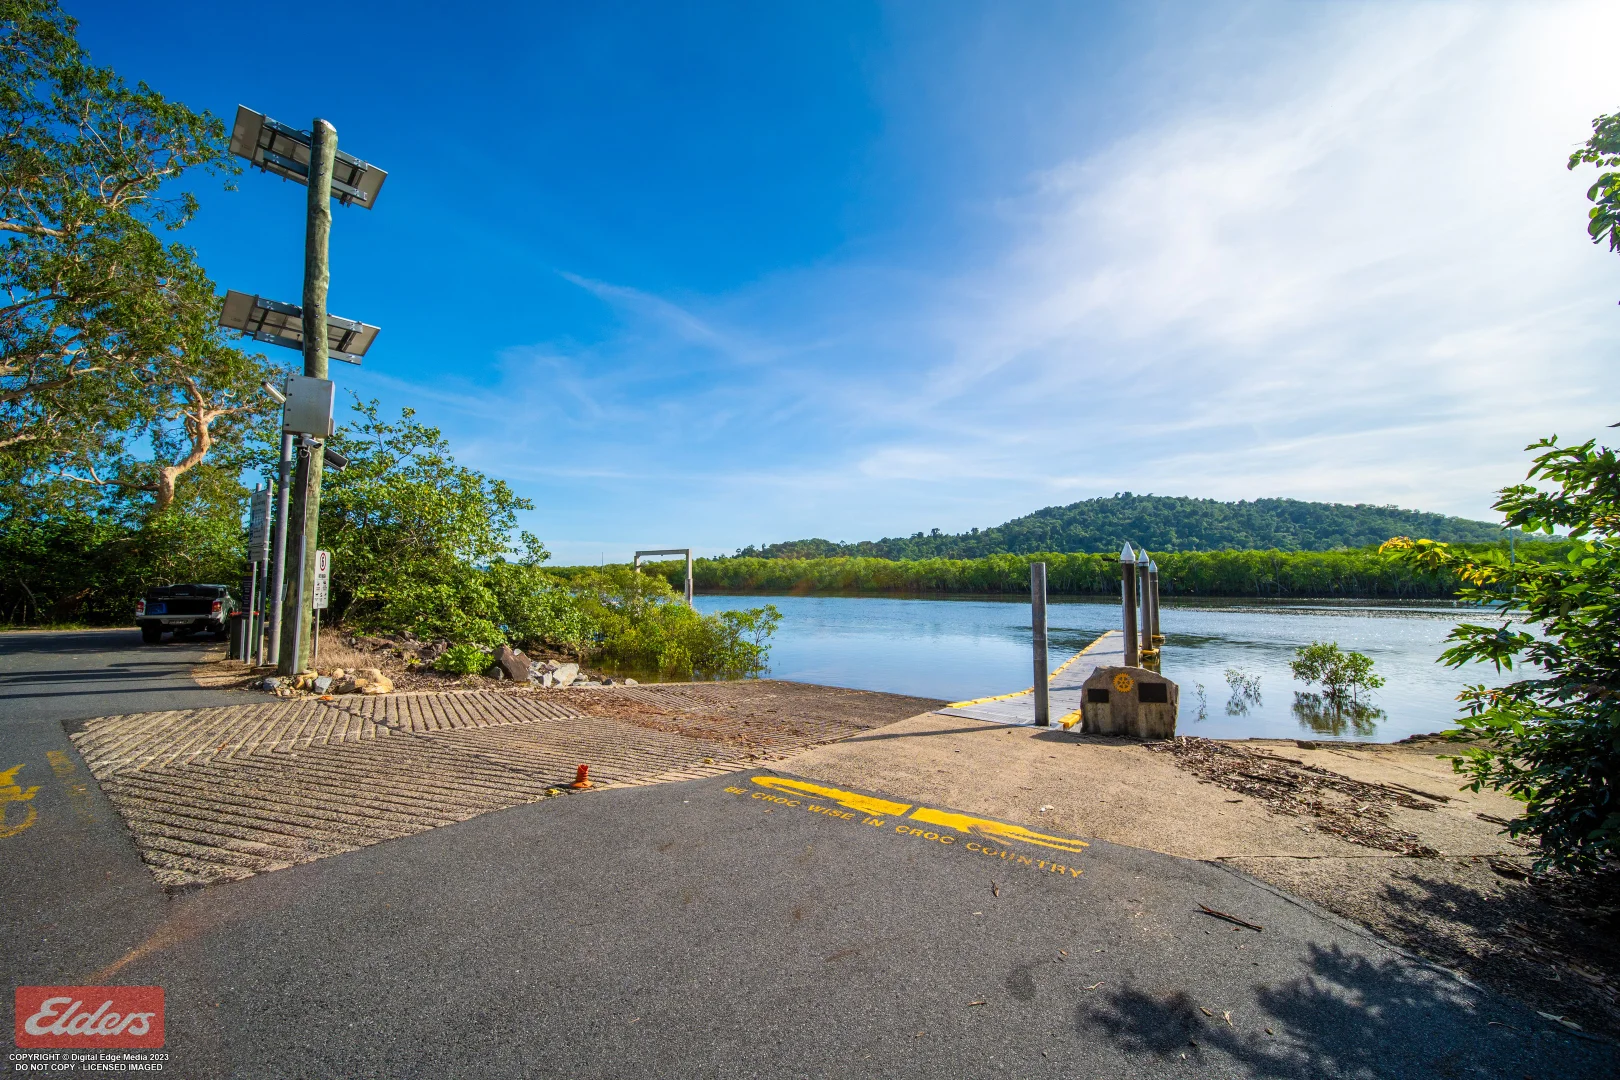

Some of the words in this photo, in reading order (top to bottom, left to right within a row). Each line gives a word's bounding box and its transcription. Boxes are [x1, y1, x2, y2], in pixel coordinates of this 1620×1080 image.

[751, 792, 801, 807] CROC
[808, 804, 856, 821] WISE
[862, 816, 886, 827] IN
[895, 825, 955, 845] CROC
[965, 842, 1084, 878] COUNTRY
